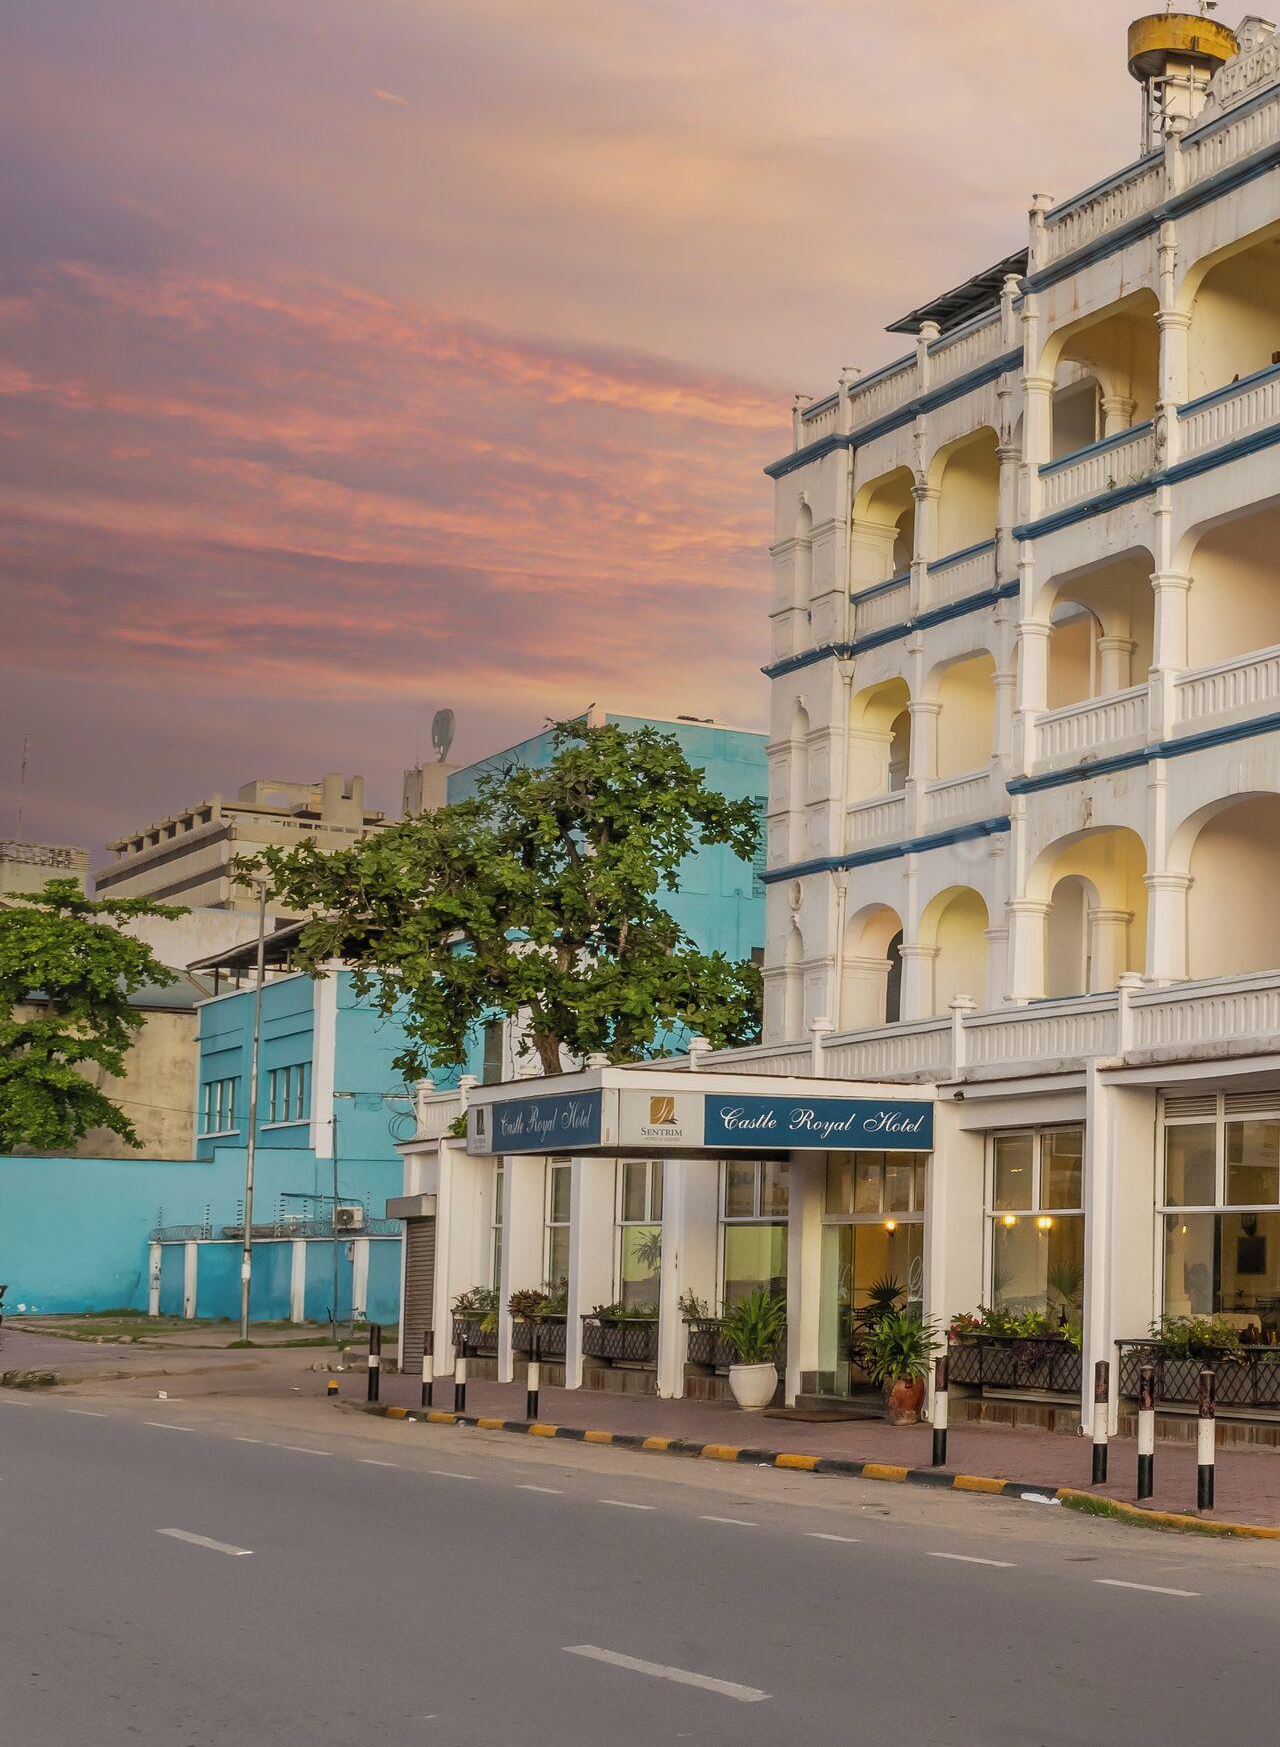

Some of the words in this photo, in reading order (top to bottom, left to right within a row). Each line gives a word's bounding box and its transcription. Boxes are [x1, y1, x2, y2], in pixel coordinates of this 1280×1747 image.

[500, 1110, 524, 1136] Castle
[526, 1105, 558, 1143] Royal
[561, 1100, 593, 1130] Hotel
[640, 1126, 683, 1137] SENTRIM
[720, 1106, 778, 1131] Castle
[789, 1108, 857, 1139] Royal
[862, 1111, 925, 1133] Hotel
